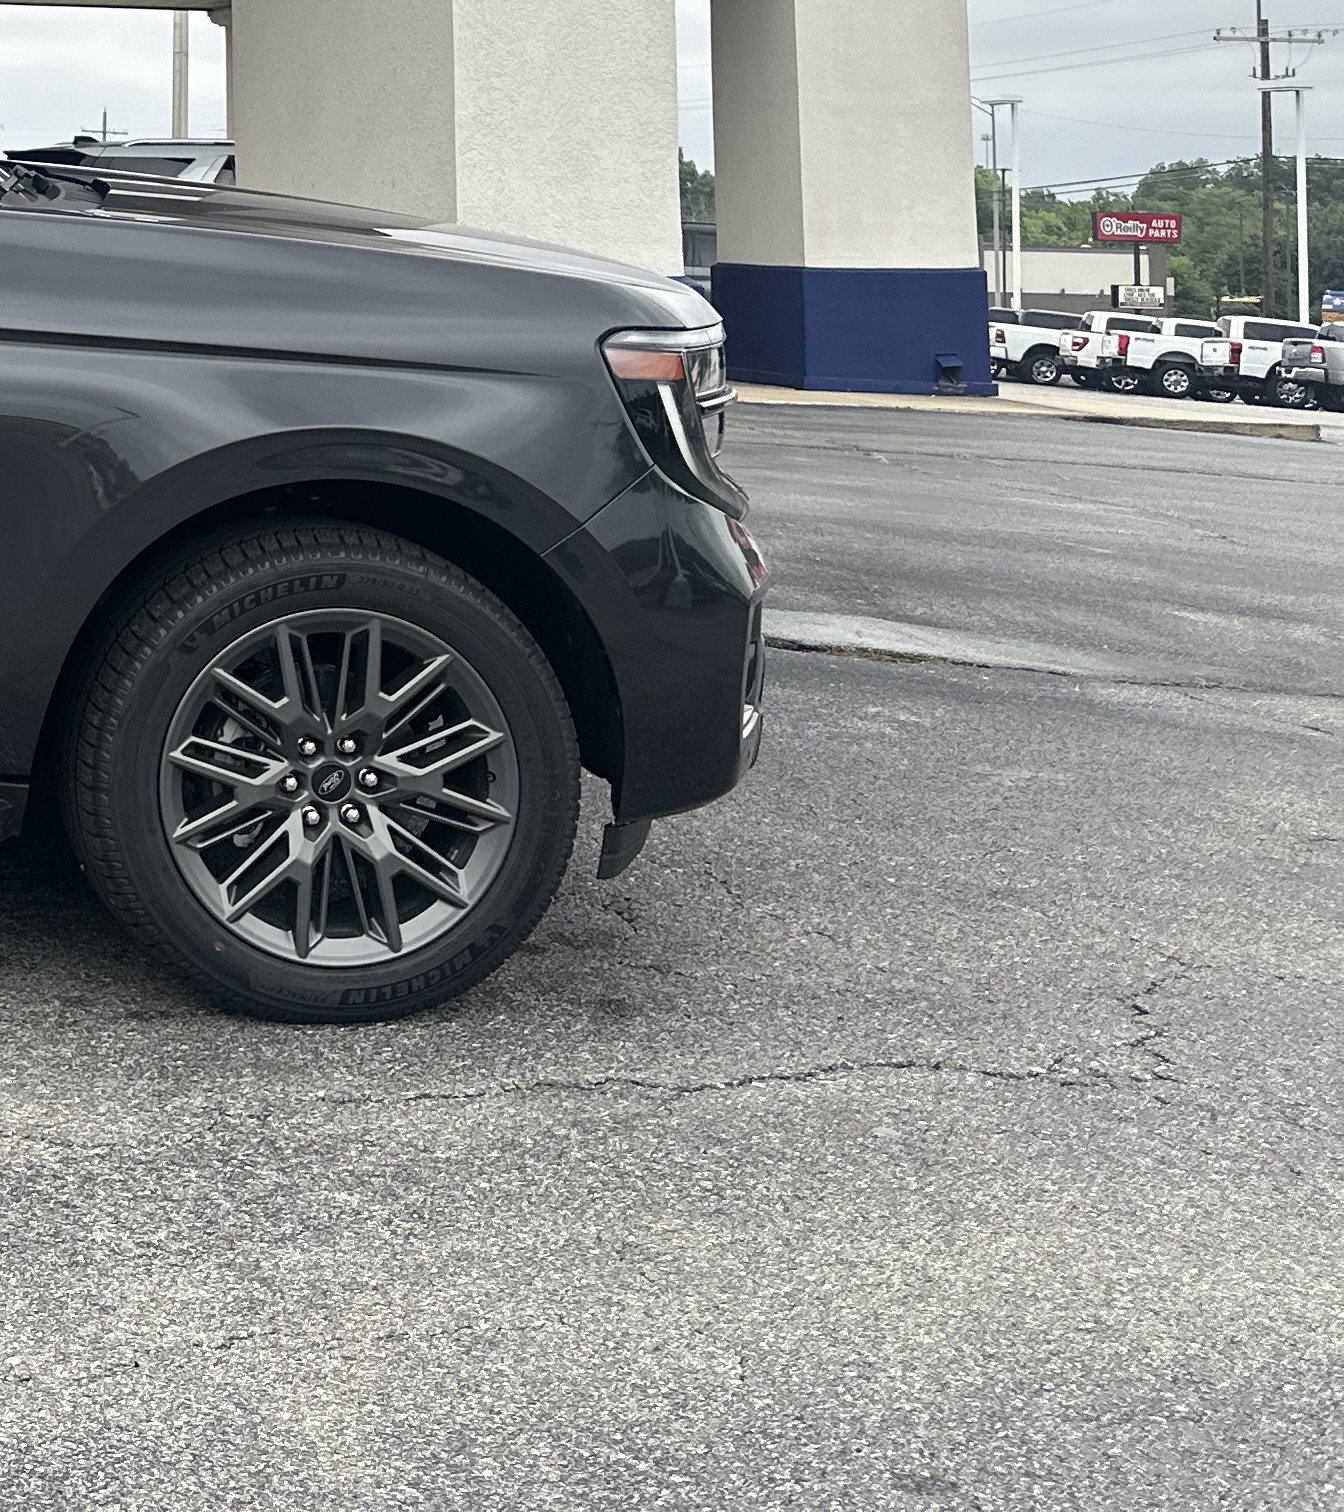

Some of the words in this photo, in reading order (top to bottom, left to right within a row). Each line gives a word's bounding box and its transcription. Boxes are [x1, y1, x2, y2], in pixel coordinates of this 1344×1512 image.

[1101, 218, 1146, 237] O'Reilly
[1151, 219, 1177, 229] AUTO
[1148, 228, 1178, 238] PARTS
[212, 574, 340, 630] MICHELIN
[348, 948, 472, 1005] MICHELIN
